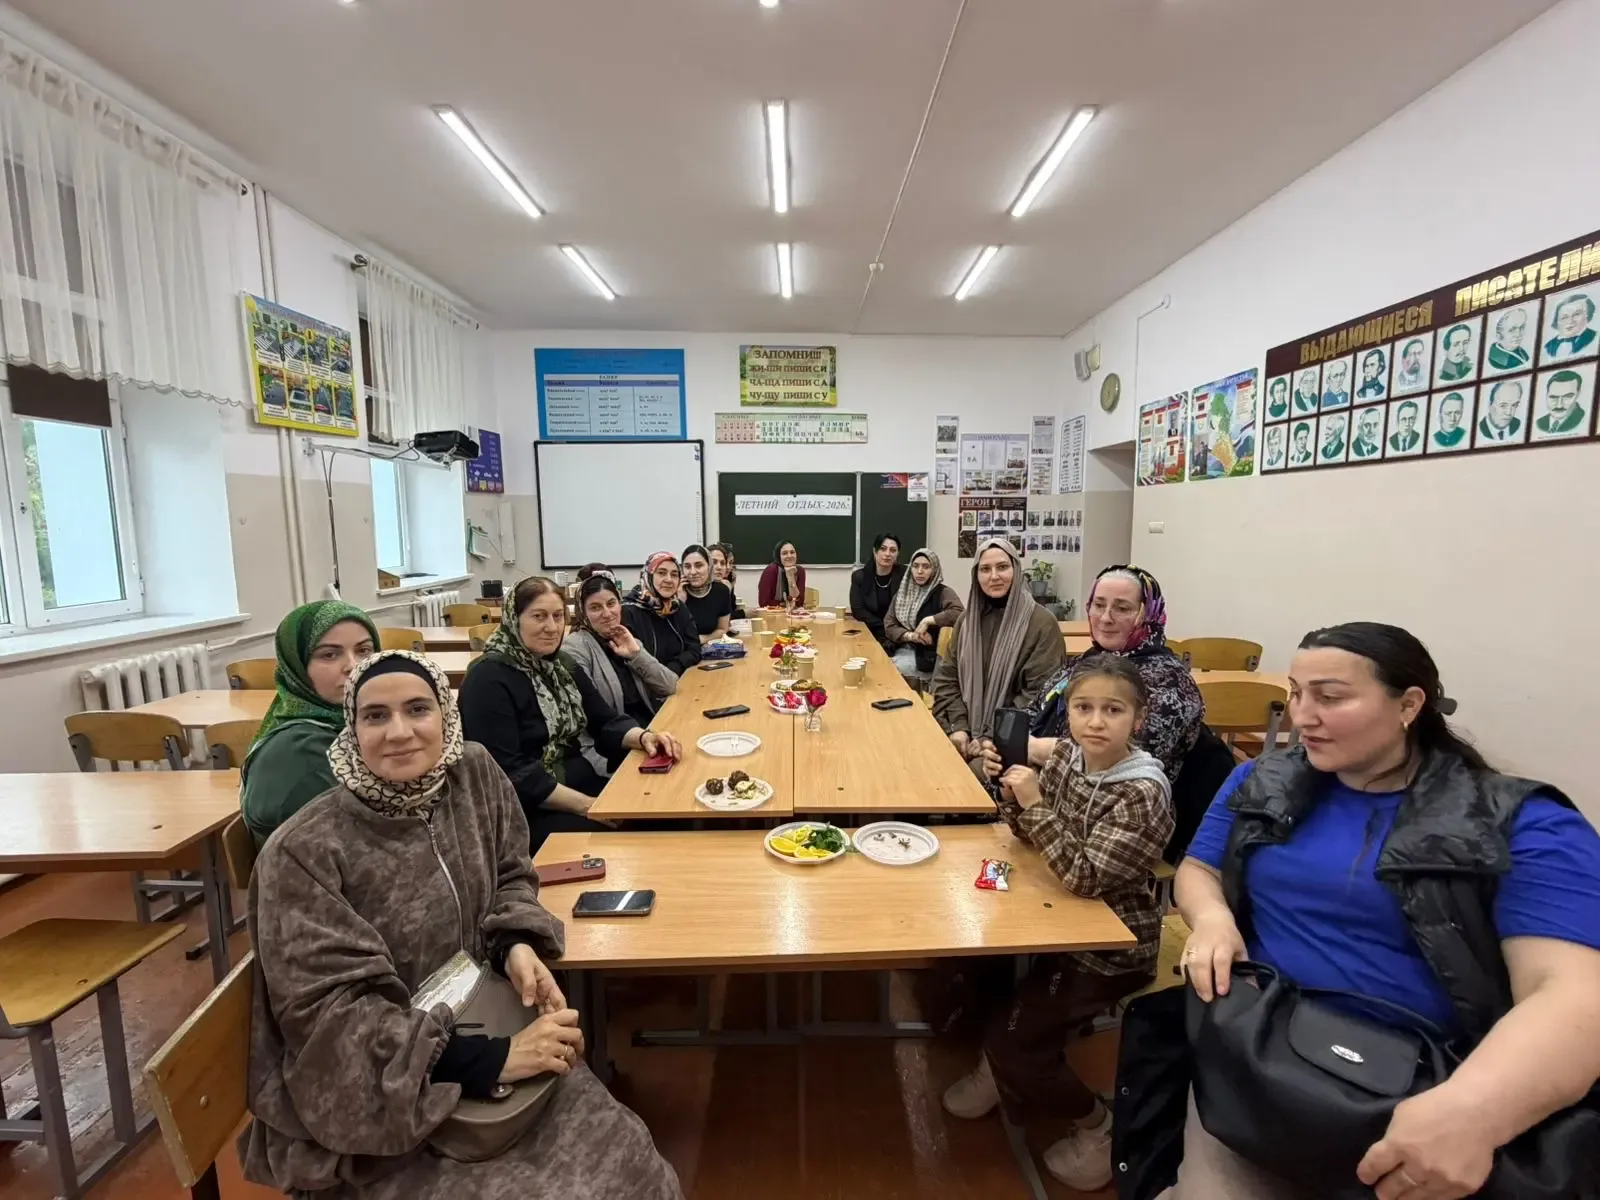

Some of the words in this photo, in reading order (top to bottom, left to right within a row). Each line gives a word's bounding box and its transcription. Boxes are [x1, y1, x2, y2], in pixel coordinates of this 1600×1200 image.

[1300, 299, 1433, 365] ВЫДАЮЩИЕСЯ
[1454, 240, 1600, 317] ПИСАТЕЛИ
[749, 379, 781, 388] ЧА-ЩА
[821, 379, 828, 387] А
[749, 391, 780, 400] ЧУ-ЩУ
[821, 391, 828, 400] У
